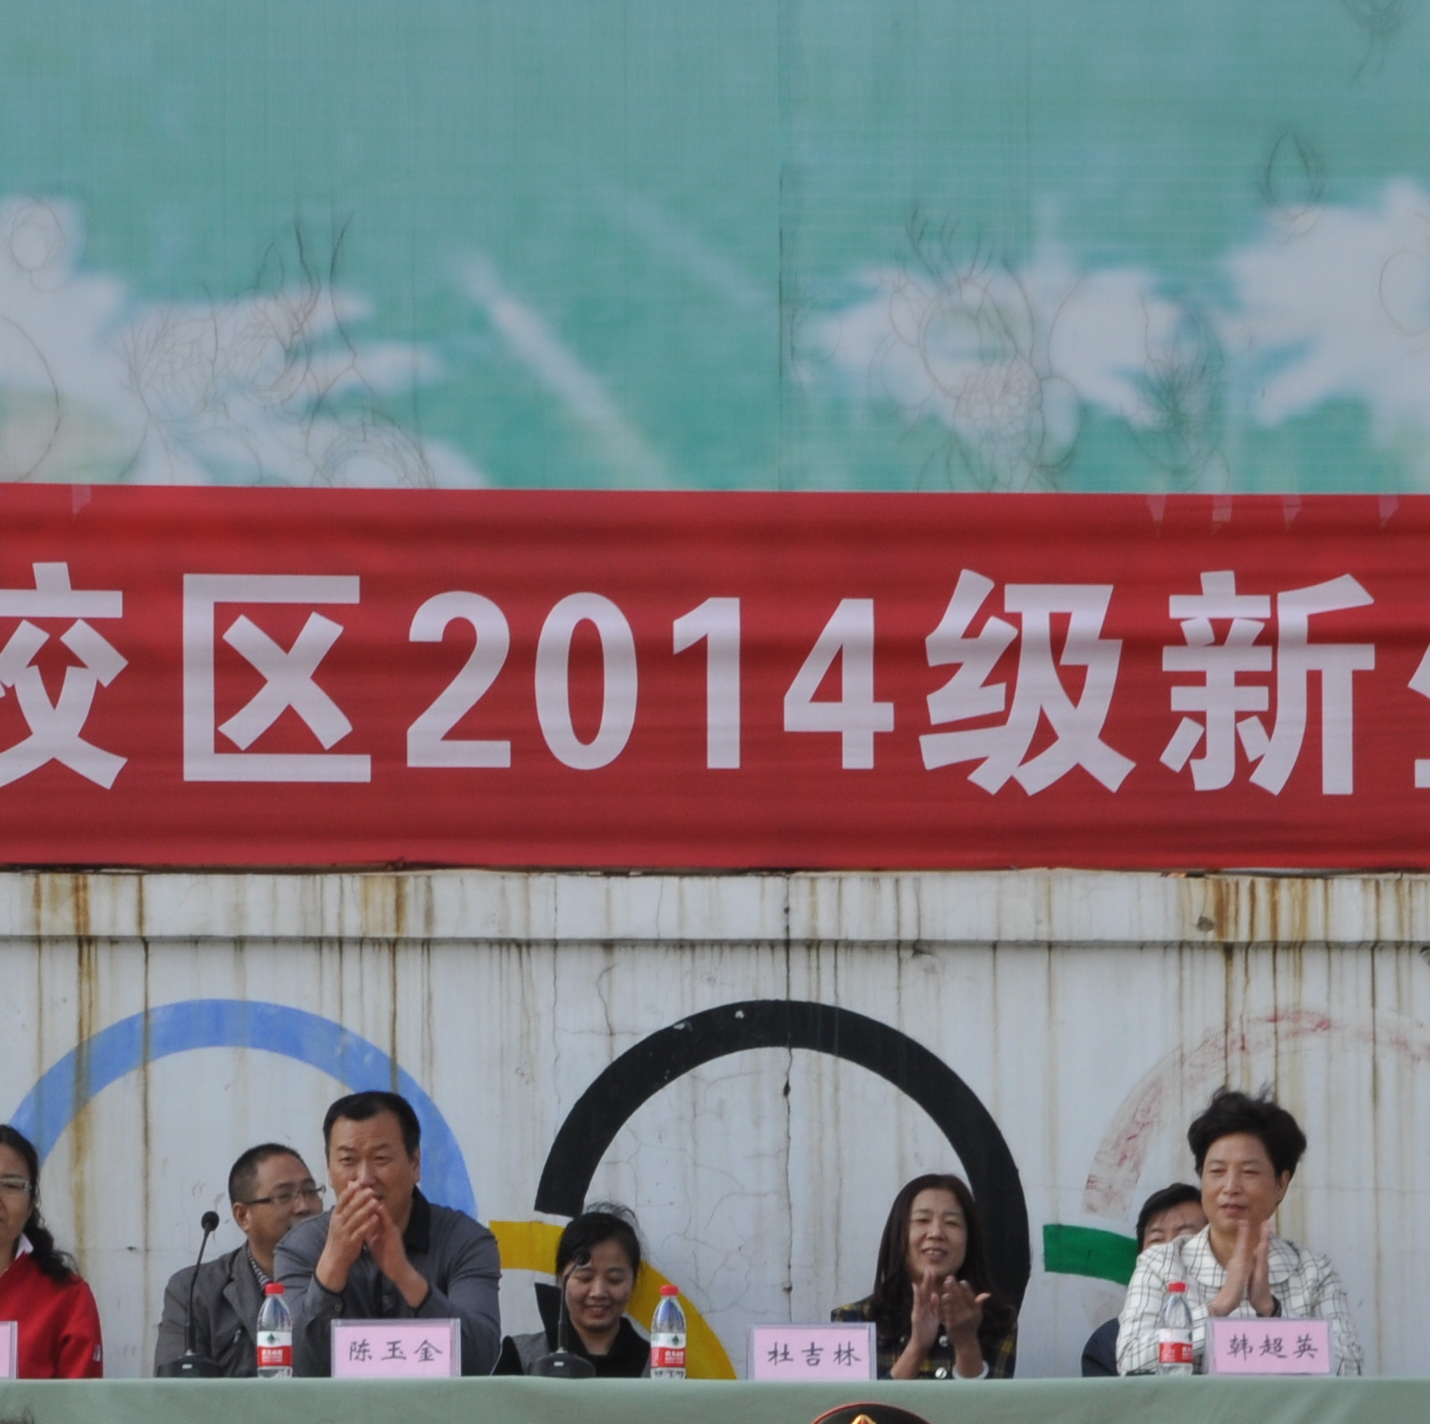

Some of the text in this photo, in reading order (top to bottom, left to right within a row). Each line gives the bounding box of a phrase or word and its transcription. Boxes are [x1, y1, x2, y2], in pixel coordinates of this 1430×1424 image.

[348, 1338, 444, 1363] 陈玉金
[767, 1340, 862, 1367] 杜吉林
[1226, 1334, 1319, 1361] 韩超英
